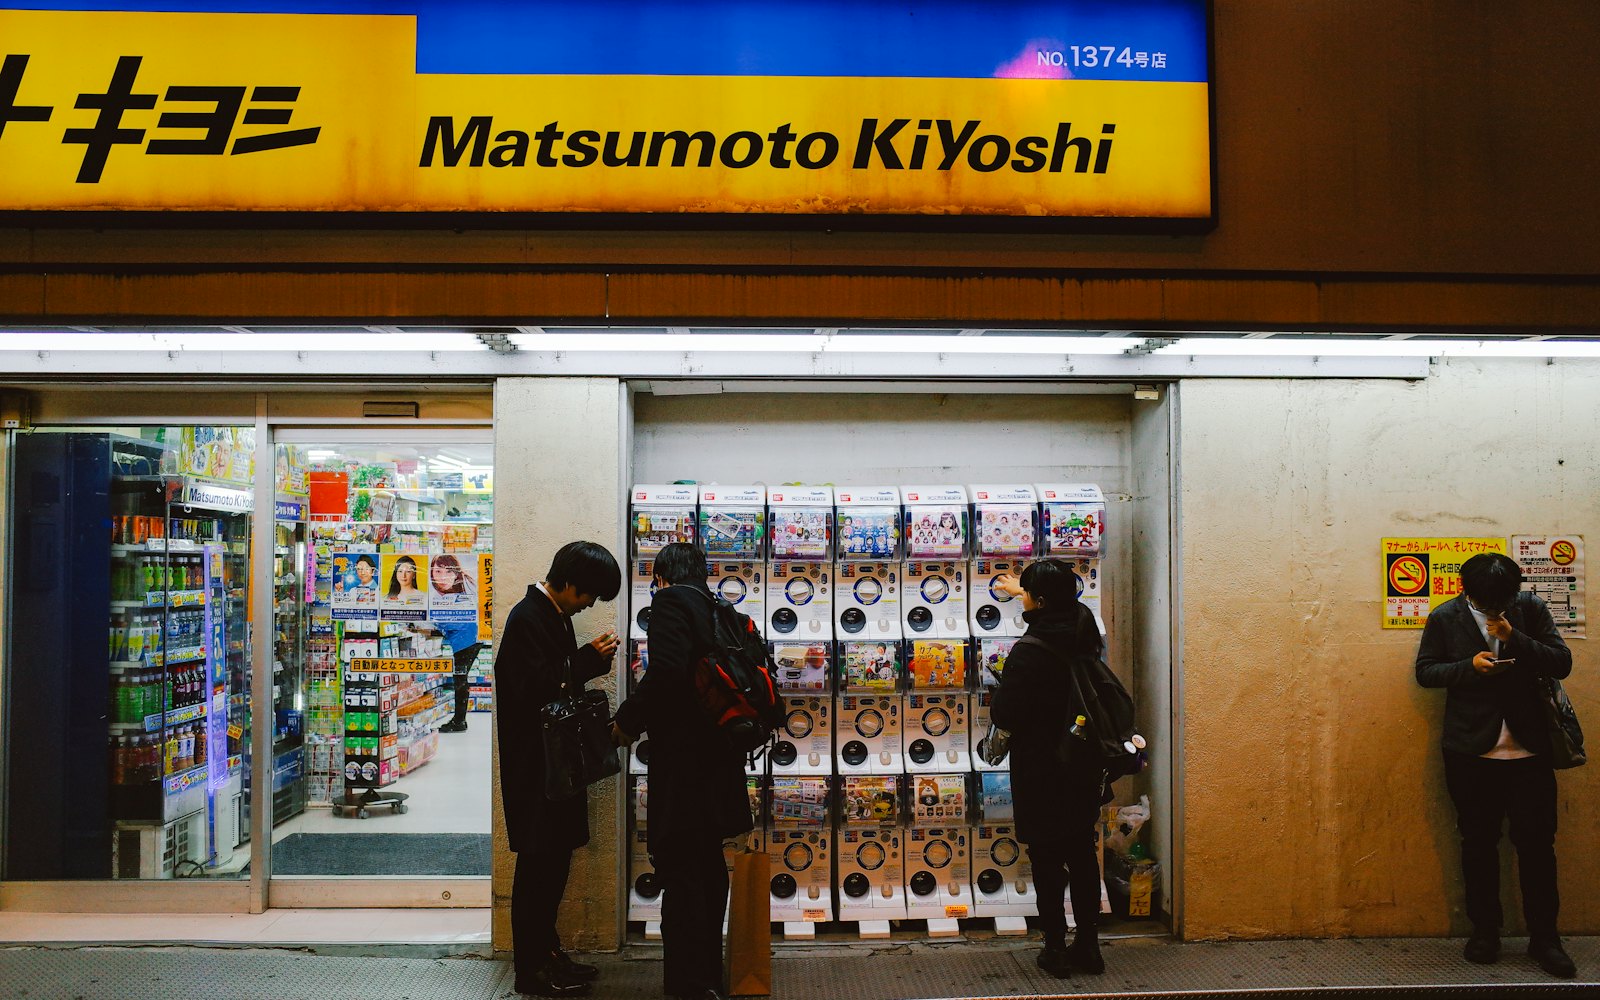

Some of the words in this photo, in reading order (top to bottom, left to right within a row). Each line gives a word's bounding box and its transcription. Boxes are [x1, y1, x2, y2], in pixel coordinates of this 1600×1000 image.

[419, 115, 840, 169] Matsumoto
[852, 117, 1116, 175] KiYoshi
[189, 488, 234, 506] Matsumoto
[353, 660, 451, 671] 自動扉となっております
